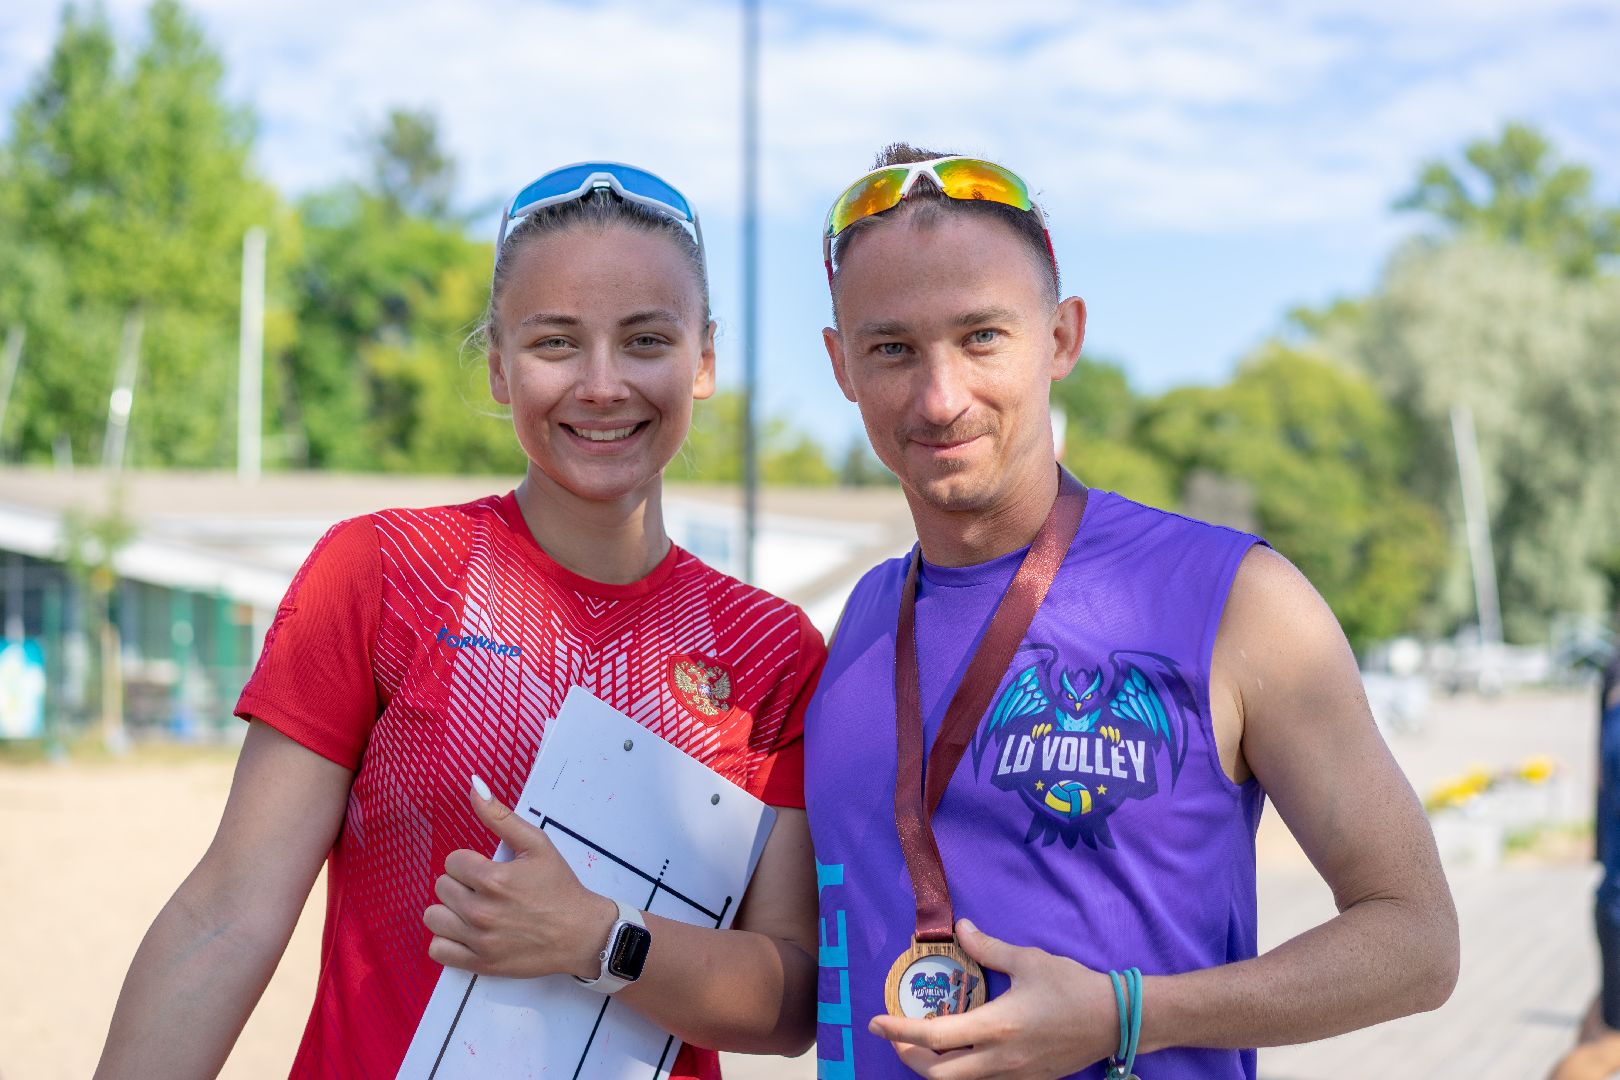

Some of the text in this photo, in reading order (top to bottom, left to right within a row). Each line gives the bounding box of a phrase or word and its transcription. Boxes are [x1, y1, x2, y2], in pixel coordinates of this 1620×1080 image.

[437, 627, 522, 657] FORWARD
[996, 734, 1146, 783] LD VOLLEY
